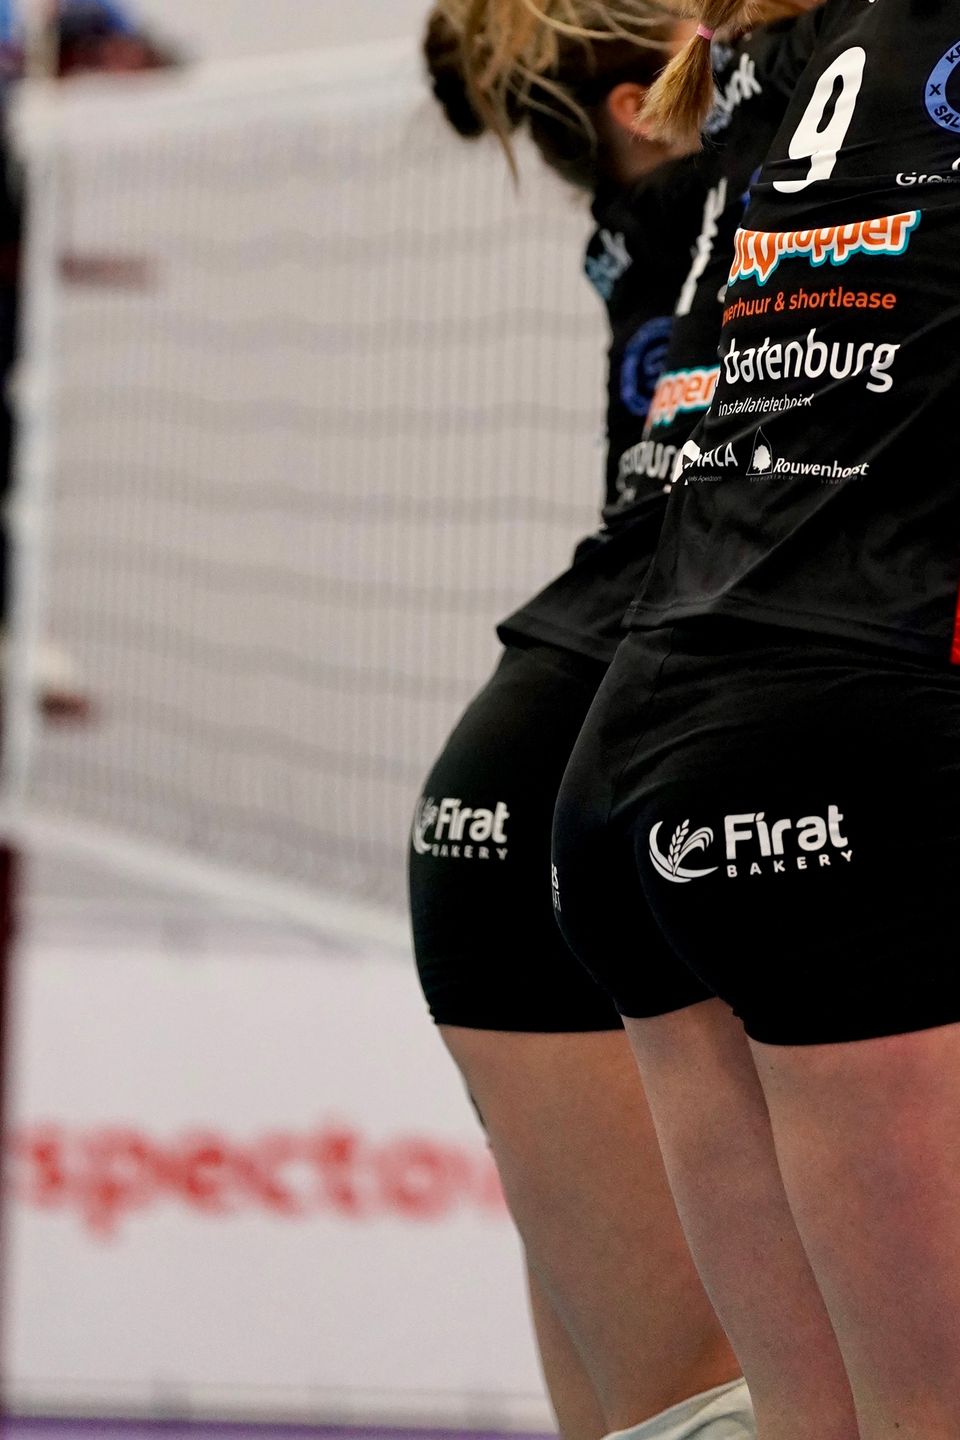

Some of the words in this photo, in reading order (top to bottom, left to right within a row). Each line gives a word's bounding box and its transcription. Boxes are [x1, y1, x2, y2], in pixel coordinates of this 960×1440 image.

[773, 46, 866, 193] 9
[775, 291, 785, 311] &
[789, 286, 897, 309] shortlease
[723, 328, 901, 394] batenburg
[434, 797, 510, 844] Firat
[725, 804, 849, 860] Firat
[431, 843, 509, 860] BAKERY
[727, 849, 853, 877] BAKERY
